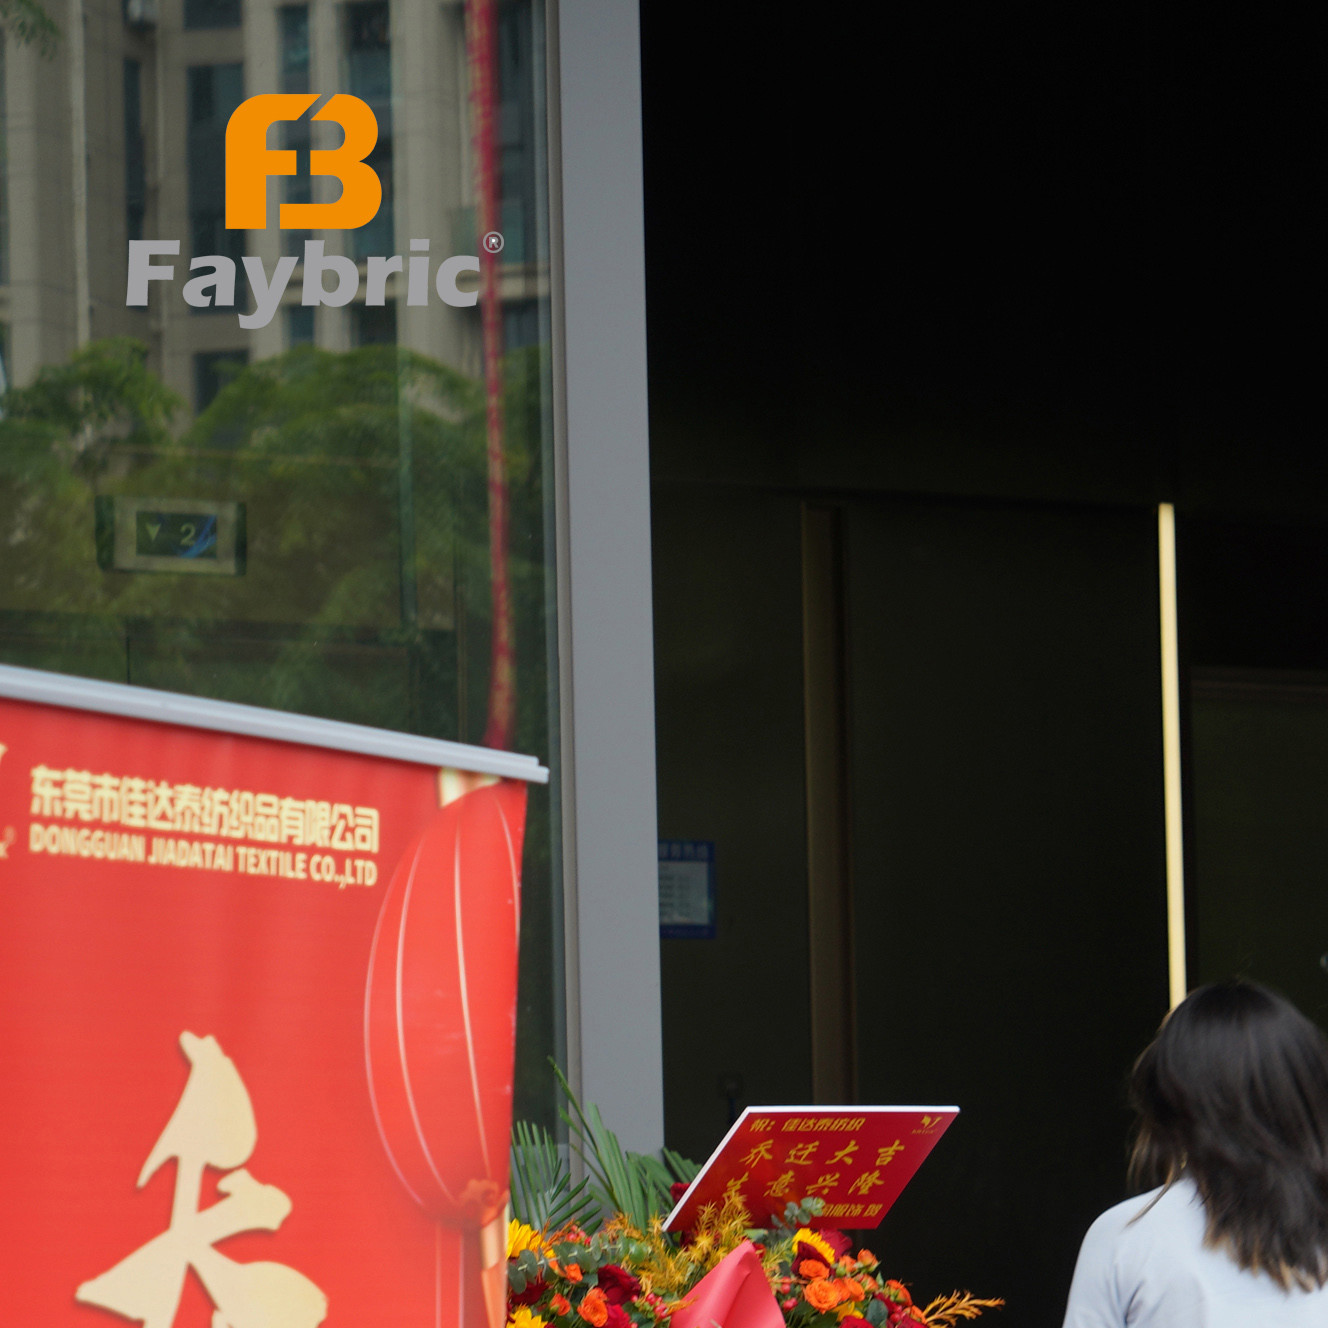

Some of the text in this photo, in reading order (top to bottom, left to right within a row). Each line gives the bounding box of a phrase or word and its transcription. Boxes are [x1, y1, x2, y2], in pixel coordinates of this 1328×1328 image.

[30, 765, 380, 853] 东莞市佳达泰纺织品有限公司
[29, 823, 146, 863] DONGGUAN
[147, 836, 235, 872] JIADATAI
[236, 846, 307, 880] TEXTILE
